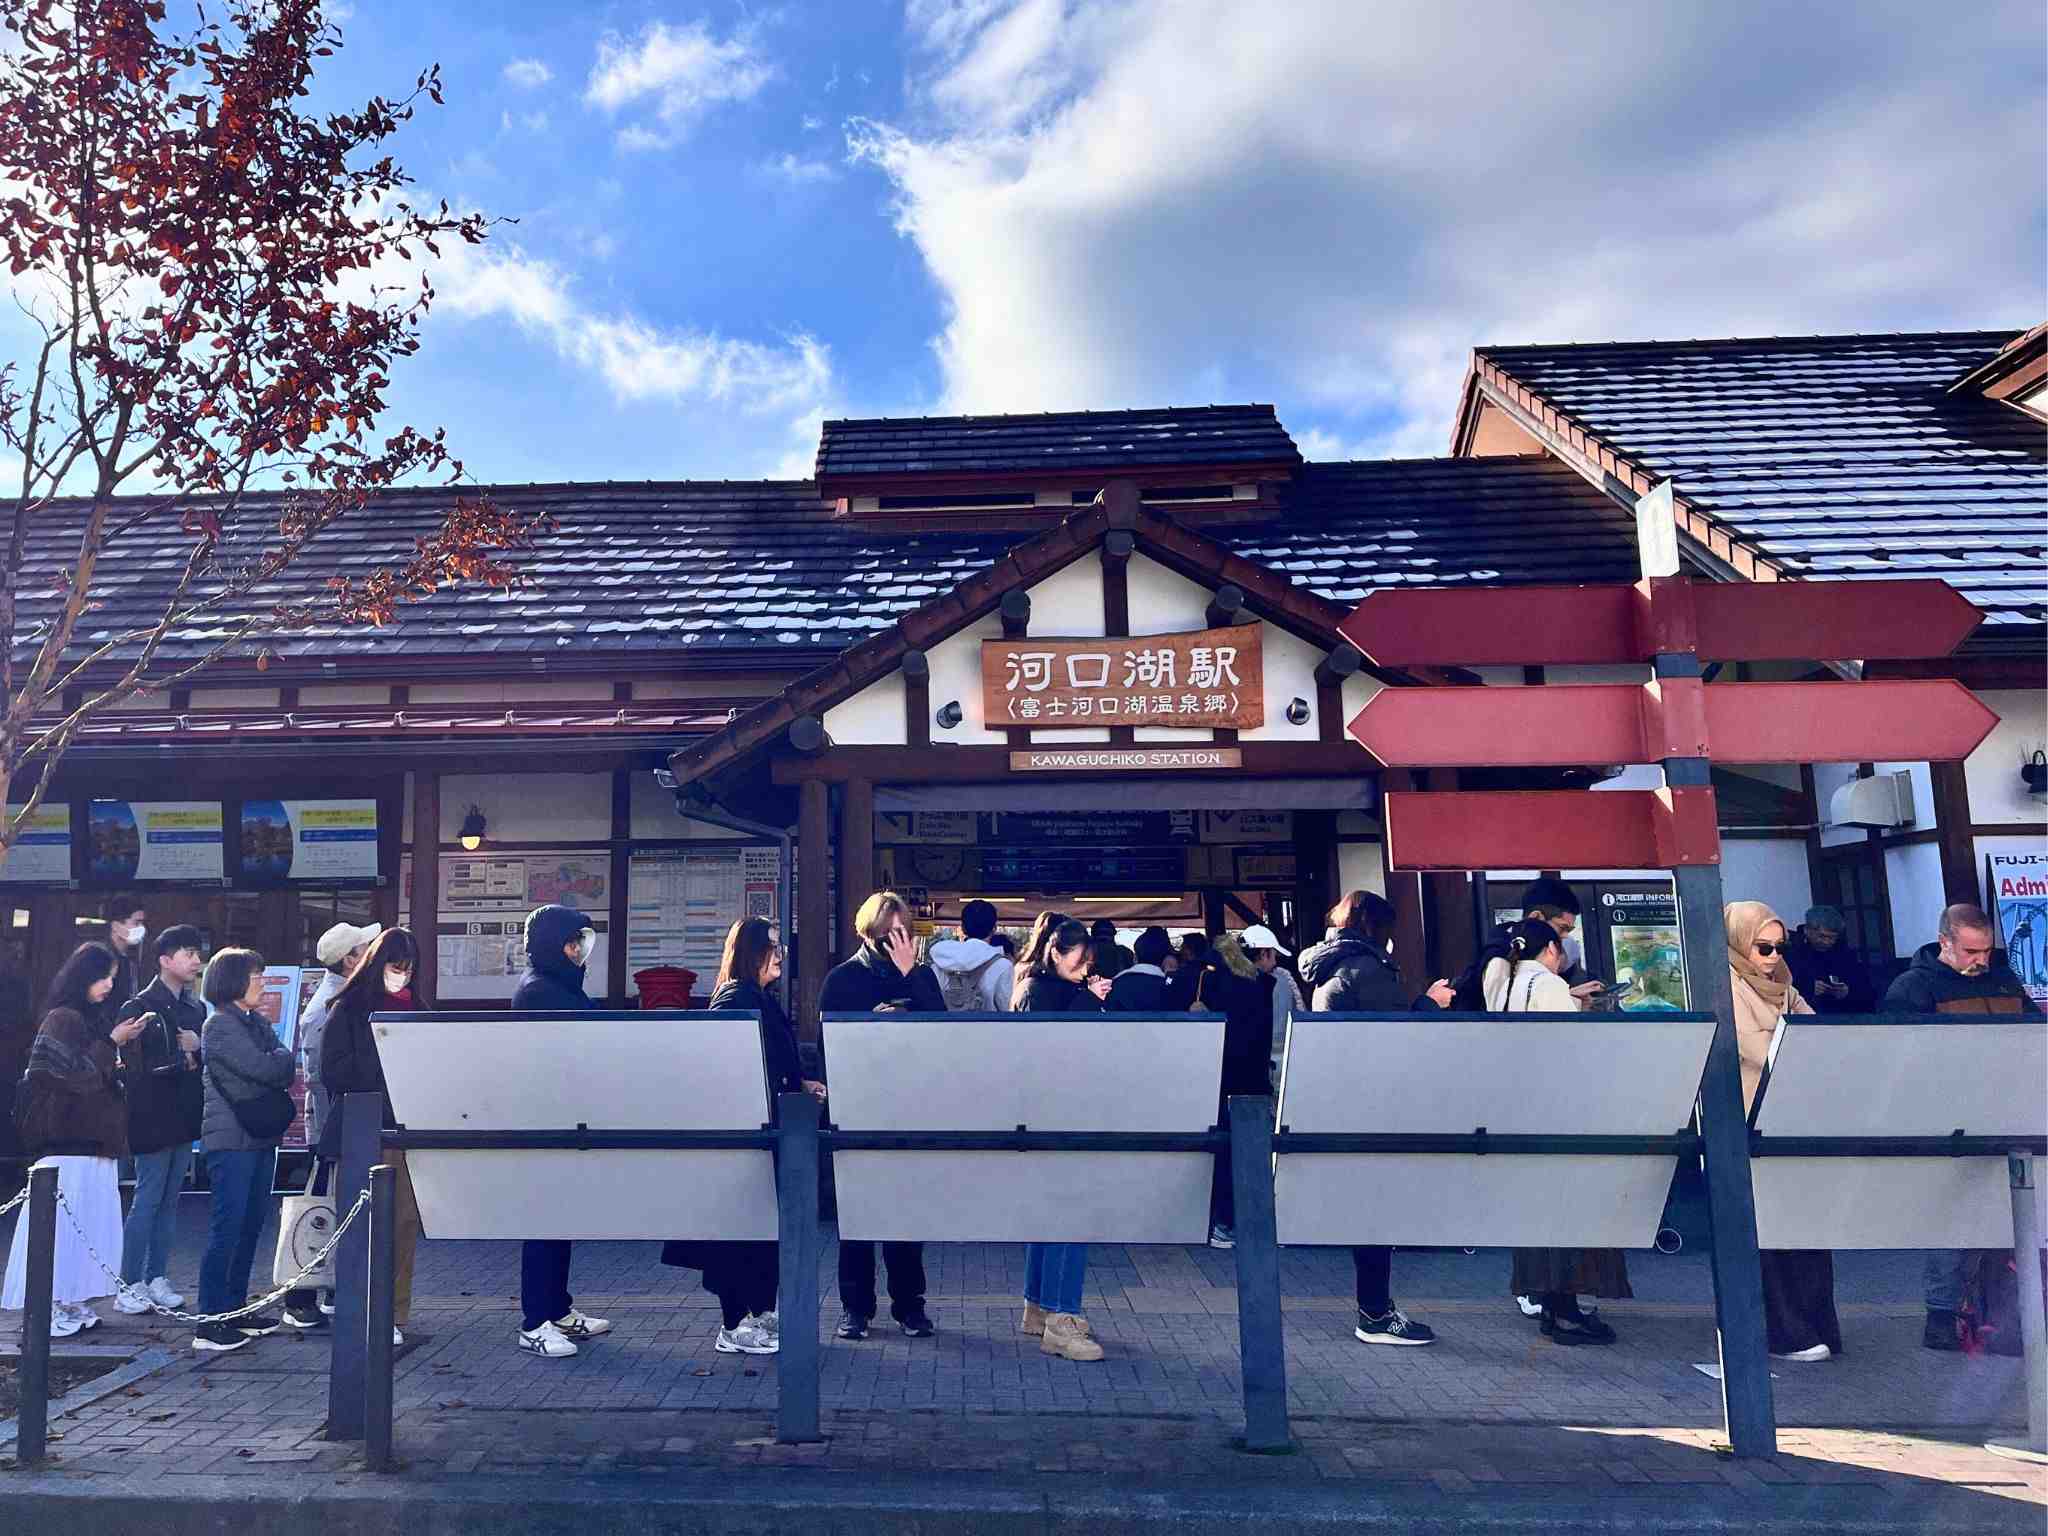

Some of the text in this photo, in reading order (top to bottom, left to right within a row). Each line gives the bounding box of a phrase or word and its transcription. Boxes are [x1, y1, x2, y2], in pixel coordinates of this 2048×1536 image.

[1005, 647, 1241, 692] 河口湖駅
[1031, 753, 1220, 767] KAWAGUCHIKO STATION
[1995, 855, 2048, 866] FUJI-
